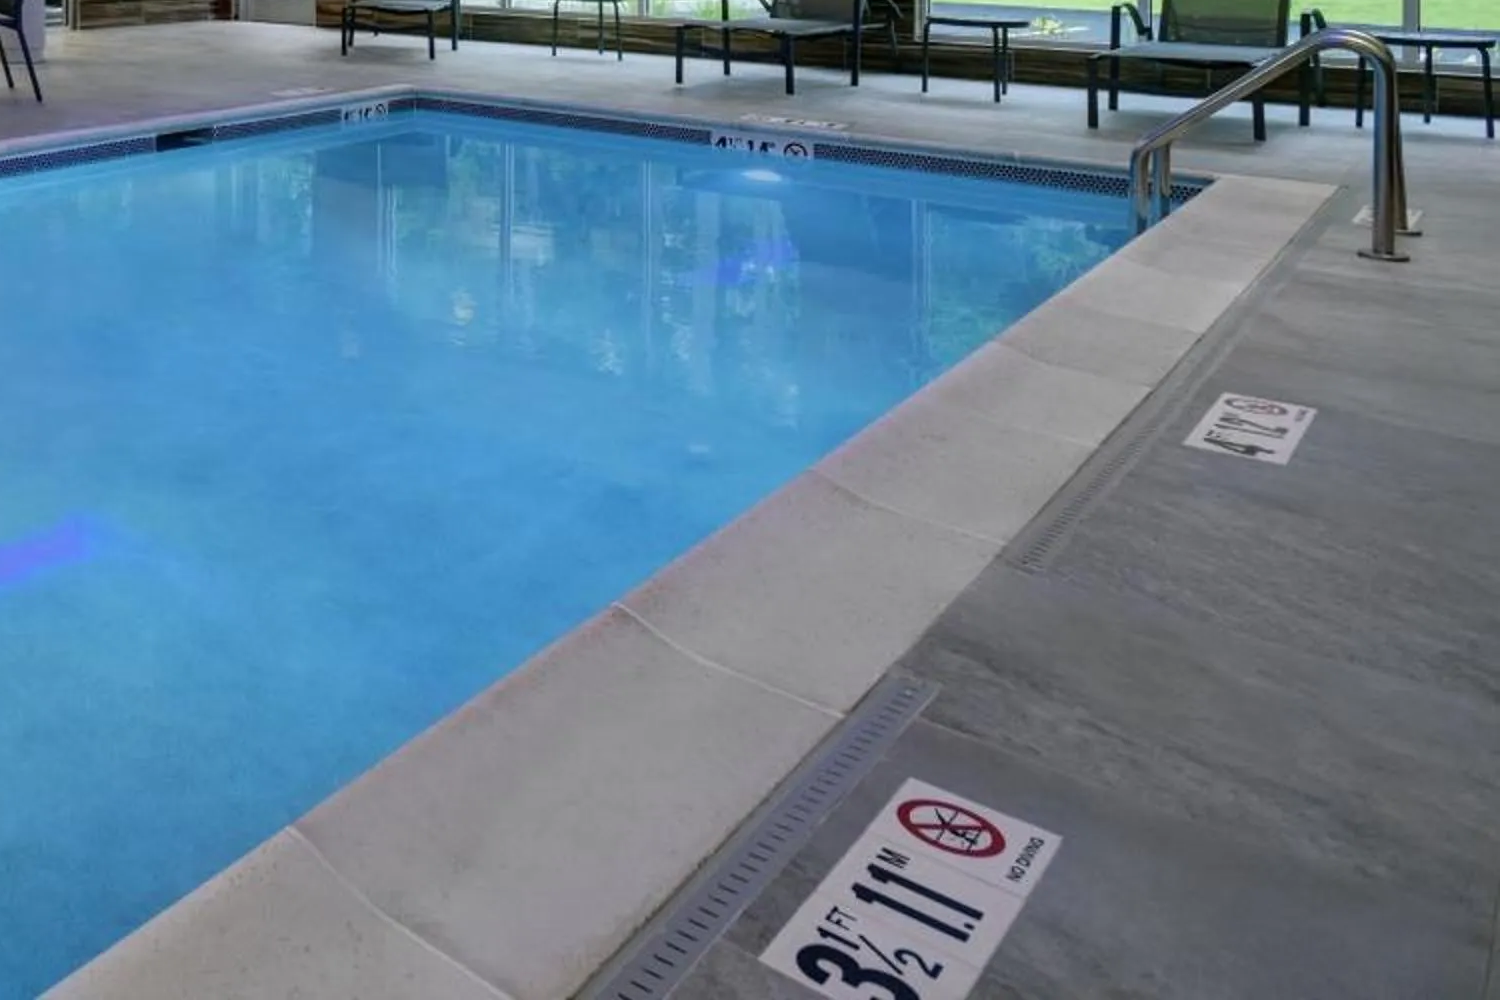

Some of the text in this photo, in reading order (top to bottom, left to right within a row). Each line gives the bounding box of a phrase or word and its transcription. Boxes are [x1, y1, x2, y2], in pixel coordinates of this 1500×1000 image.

[875, 847, 911, 869] M
[1005, 836, 1045, 883] NO DIVING
[824, 906, 858, 931] FT
[851, 863, 985, 943] 1.1
